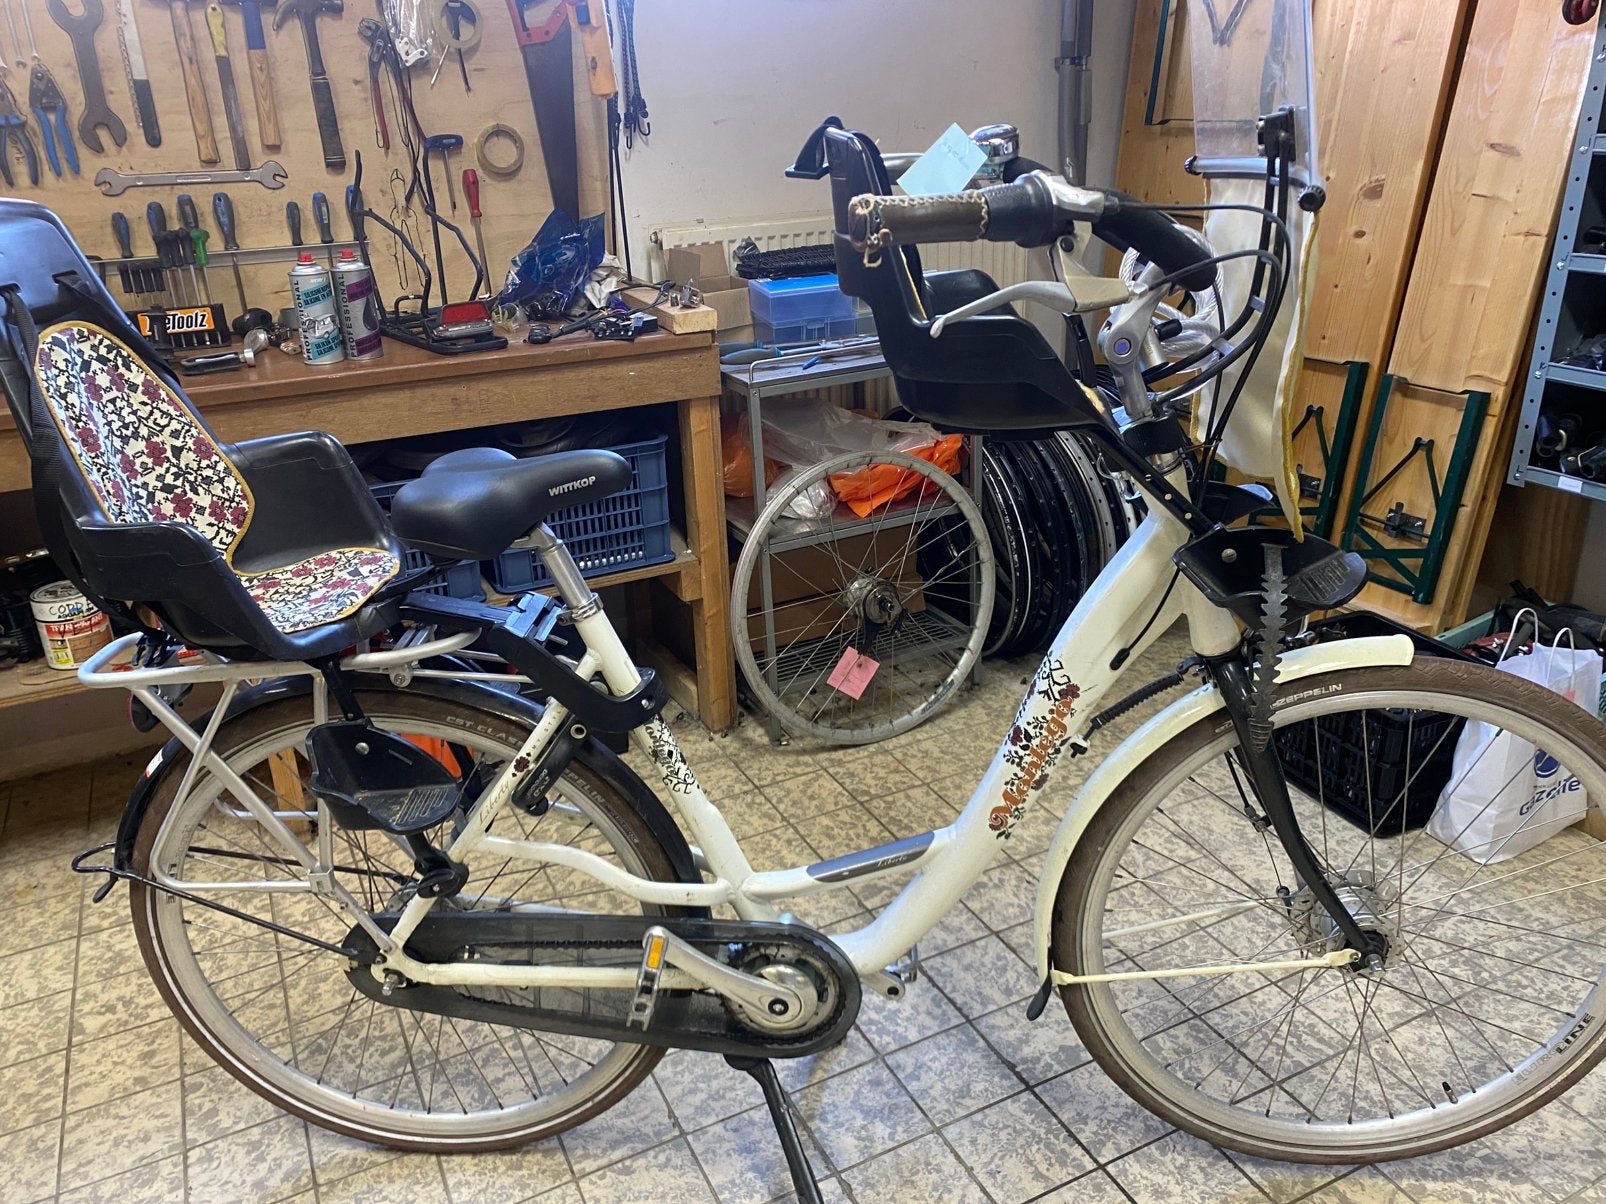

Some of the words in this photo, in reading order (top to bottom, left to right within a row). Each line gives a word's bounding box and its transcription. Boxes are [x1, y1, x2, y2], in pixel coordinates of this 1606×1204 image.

[548, 475, 596, 497] WITTKOP
[1277, 683, 1343, 707] ZEPPELIN
[989, 697, 1074, 831] Montego
[479, 780, 510, 826] Liberty
